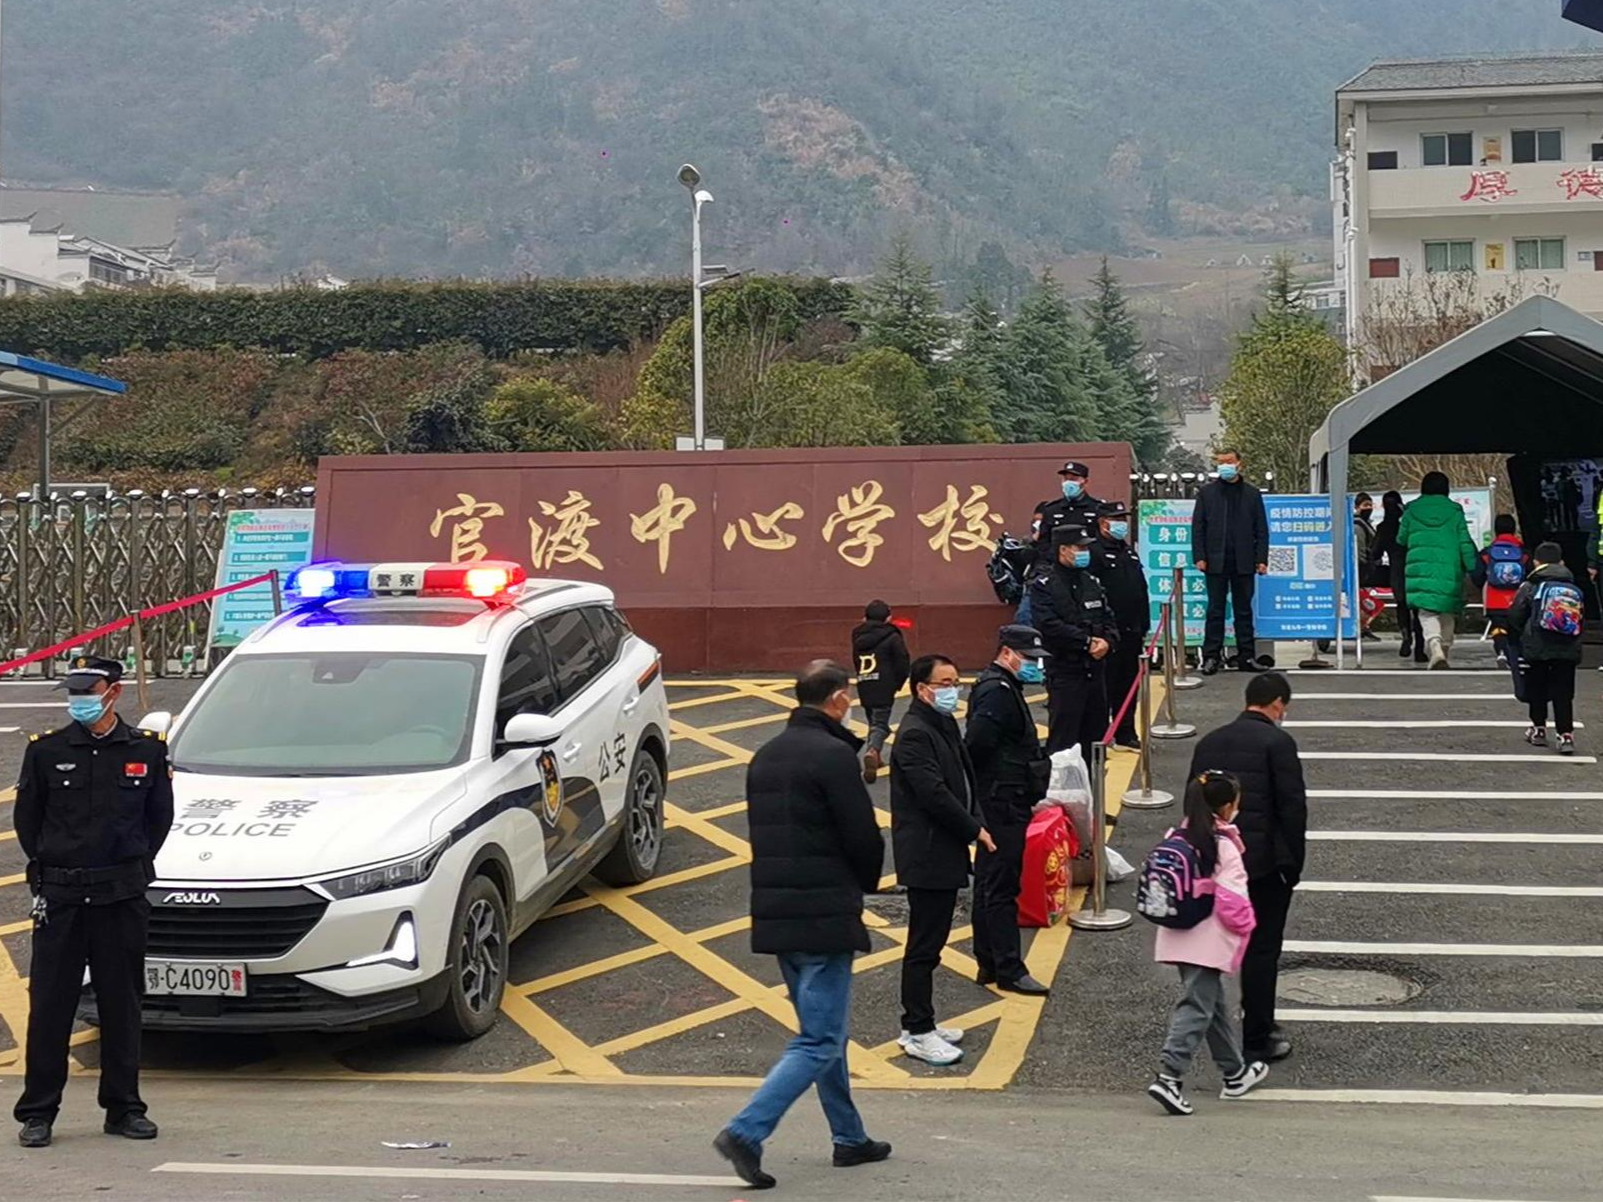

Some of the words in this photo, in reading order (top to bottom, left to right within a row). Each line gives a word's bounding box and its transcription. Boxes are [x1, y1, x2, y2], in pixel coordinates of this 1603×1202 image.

[430, 480, 1004, 574] 官渡中心学校
[377, 573, 415, 587] 警察
[1158, 577, 1205, 593] 体必
[858, 653, 877, 675] D
[598, 732, 626, 782] 公安
[179, 799, 319, 819] 警察
